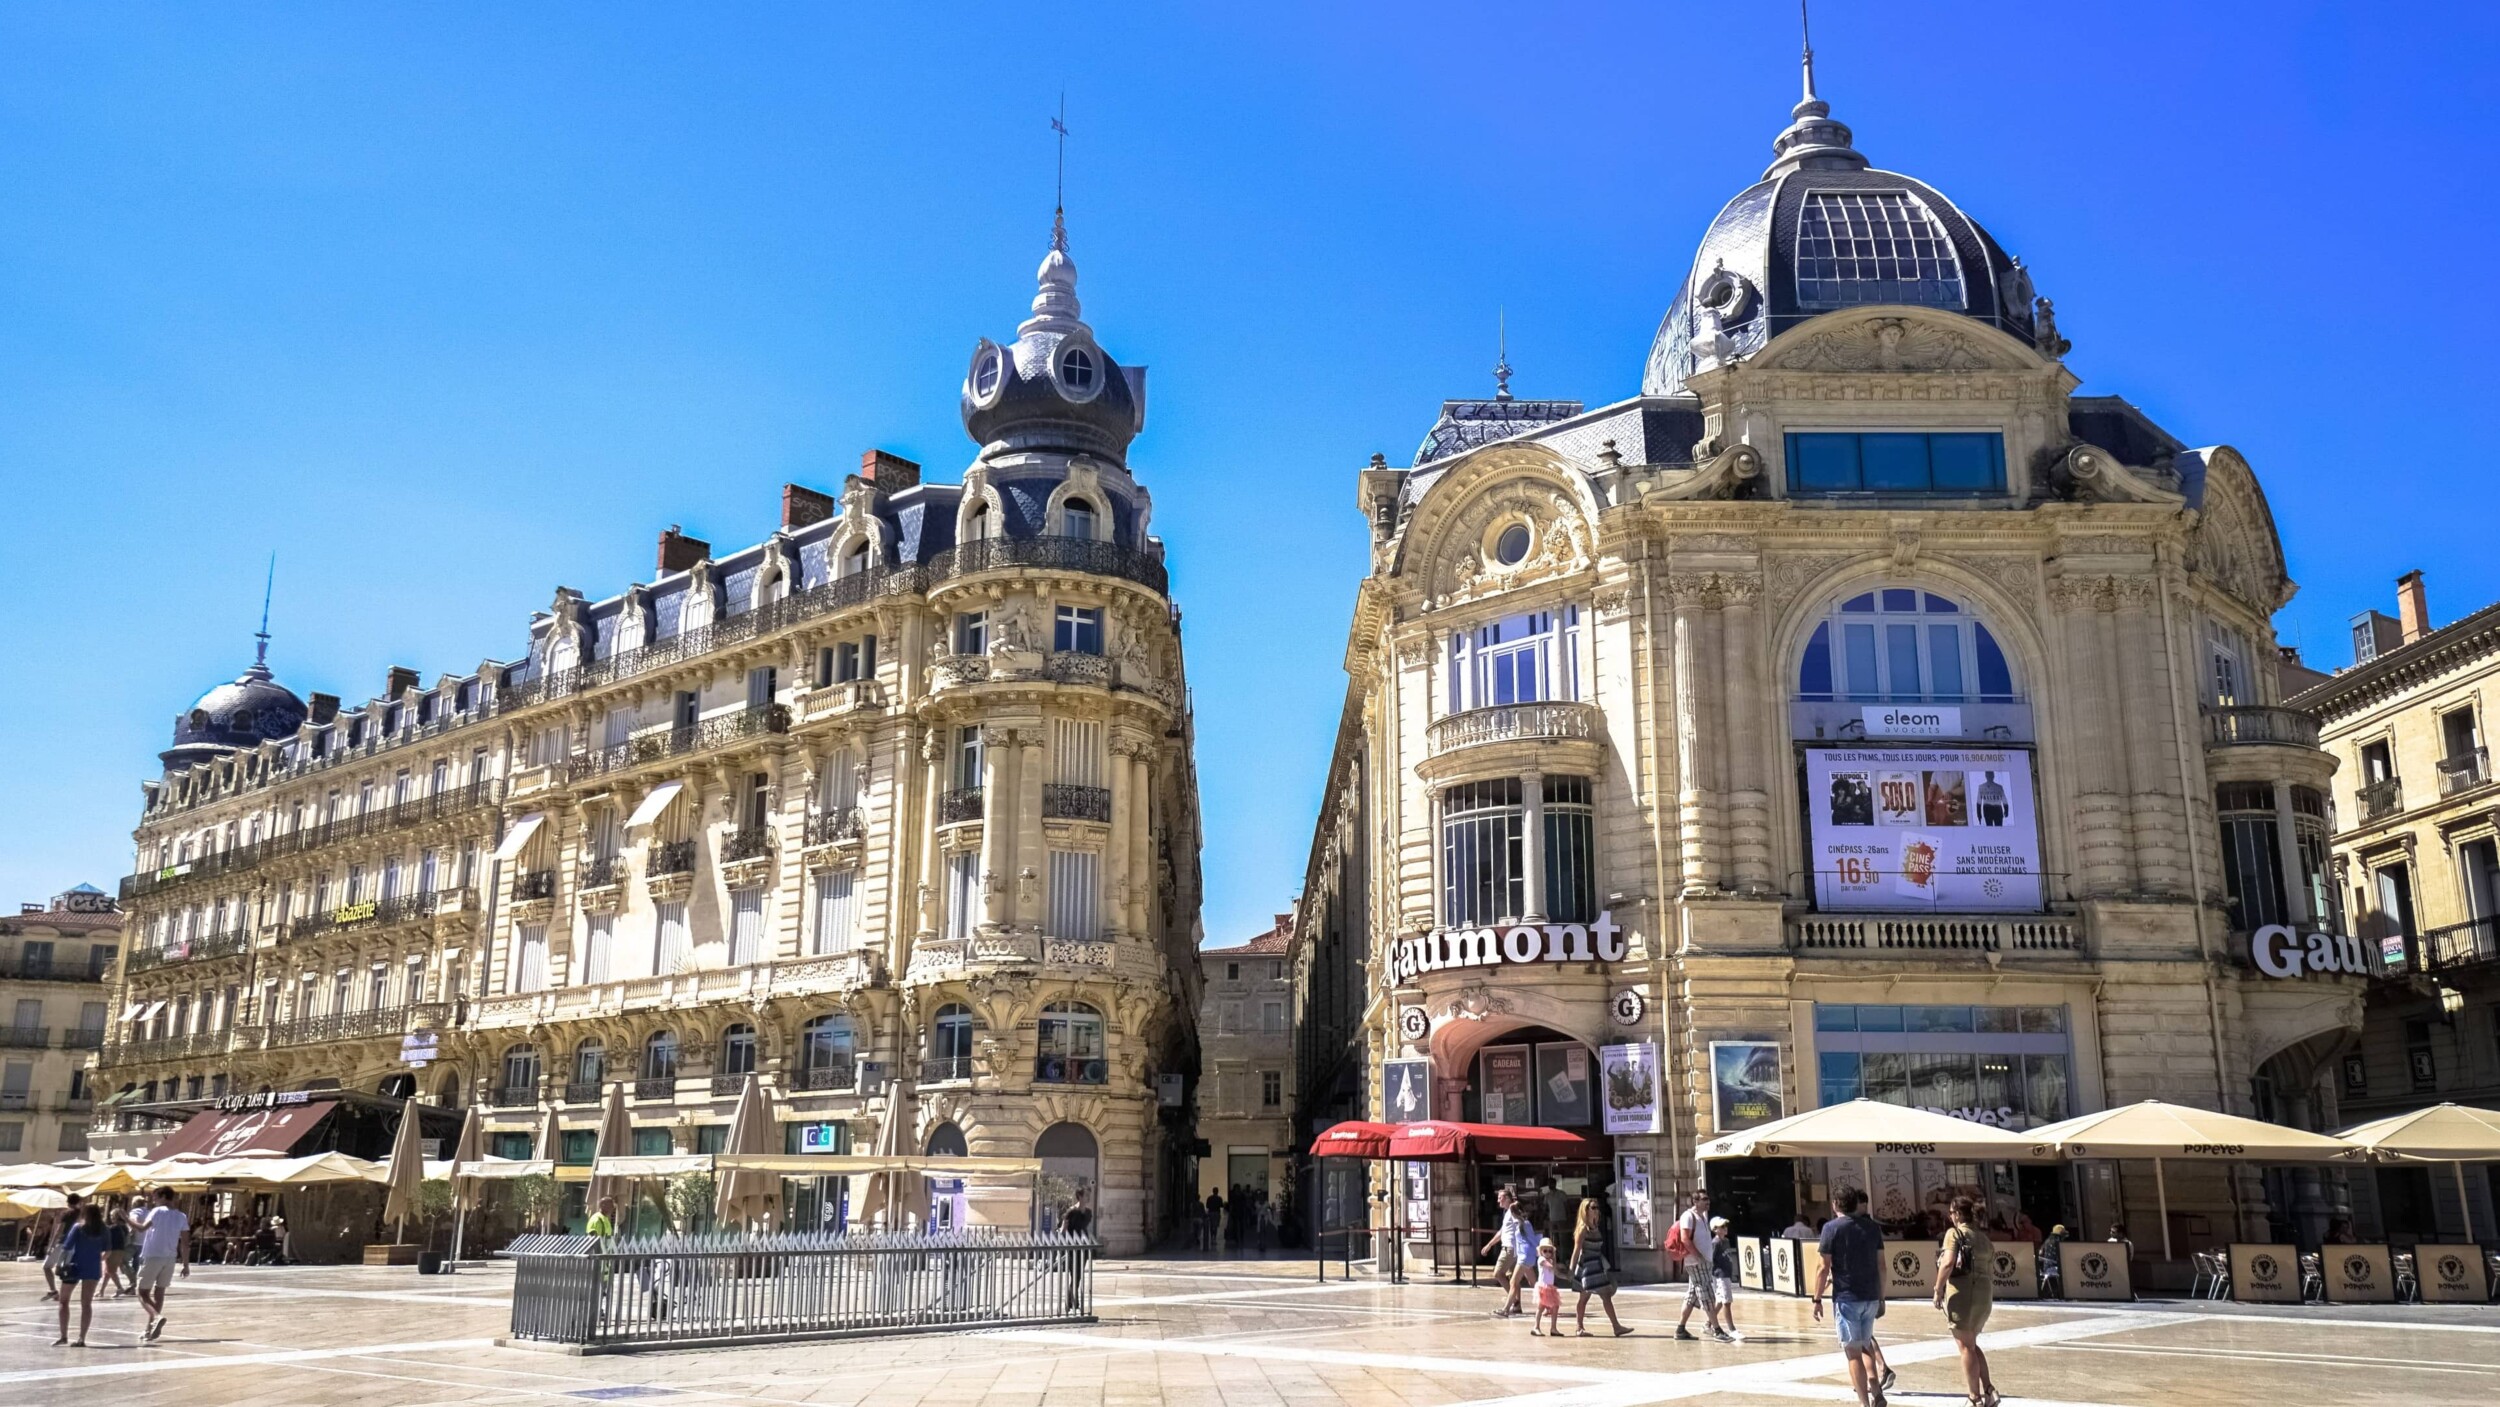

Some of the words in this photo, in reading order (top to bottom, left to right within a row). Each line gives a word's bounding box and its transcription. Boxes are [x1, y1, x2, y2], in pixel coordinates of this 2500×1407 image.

[1884, 709, 1940, 725] eleom
[1824, 753, 1841, 761] TOUS
[1844, 753, 1856, 761] LES
[1858, 754, 1880, 762] FILMS,
[1915, 754, 1938, 762] JOURS,
[1940, 754, 1959, 762] POUR
[1881, 782, 1916, 811] SOLO
[1828, 844, 1862, 854] CINÉPASS
[1865, 845, 1889, 854] -26ans
[1971, 844, 1976, 854] À
[1978, 846, 2011, 854] UTILISER
[1909, 852, 1931, 865] CINÉ
[1956, 856, 1975, 865] SANS
[1978, 855, 2025, 865] MODÉRATION
[1909, 863, 1930, 875] PASS
[1994, 865, 2027, 874] CINÉMAS
[341, 900, 375, 922] Gazette
[1388, 911, 1624, 988] Gaumont
[1618, 998, 1634, 1017] G
[1406, 1015, 1420, 1032] G
[1493, 1059, 1521, 1068] CADEAUX
[225, 1094, 246, 1111] Café
